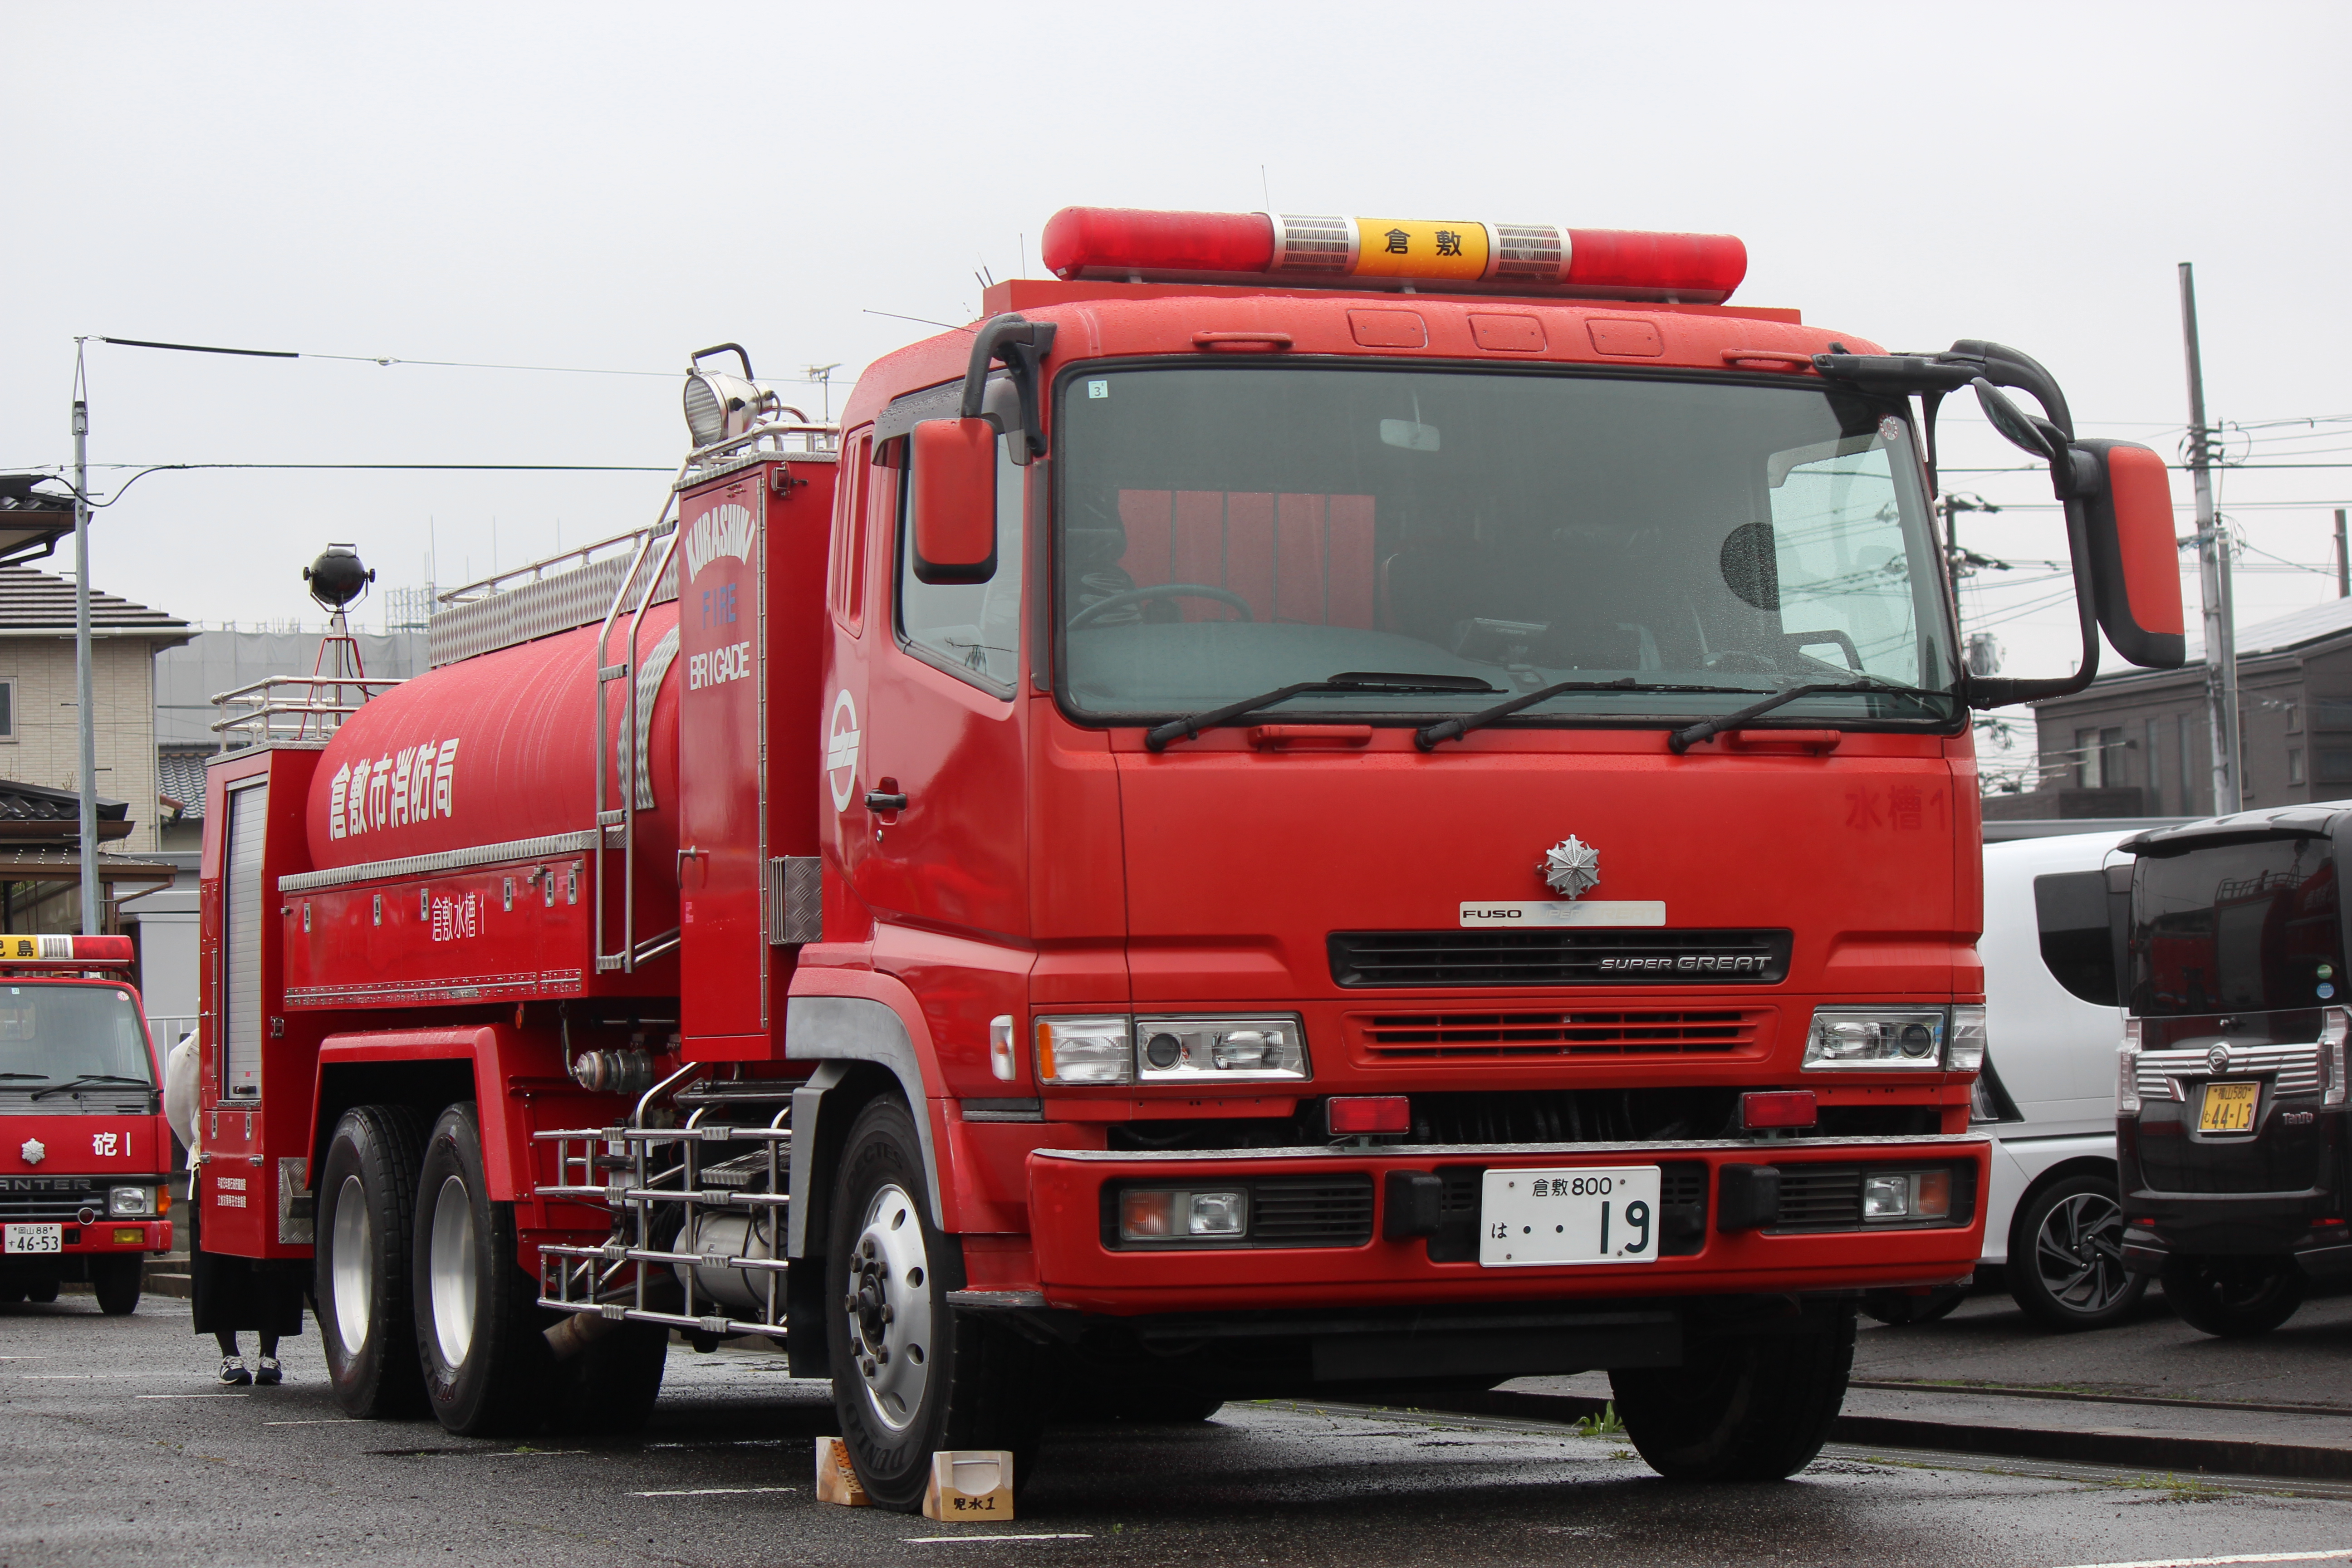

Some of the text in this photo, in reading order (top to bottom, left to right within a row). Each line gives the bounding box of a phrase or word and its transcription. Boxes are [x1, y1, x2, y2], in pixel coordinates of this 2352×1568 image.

[1385, 228, 1462, 256] 倉敷
[1094, 387, 1101, 397] 3
[702, 583, 736, 630] FIRE
[690, 641, 750, 691] BRIGADE
[330, 737, 460, 842] 倉敷市消防局
[432, 892, 484, 941] 倉敷水槽1
[1462, 910, 1522, 918] FUSO
[1601, 956, 1772, 971] SUPER GREAT
[1492, 1222, 1508, 1239] は
[17, 1236, 59, 1251] 46-53
